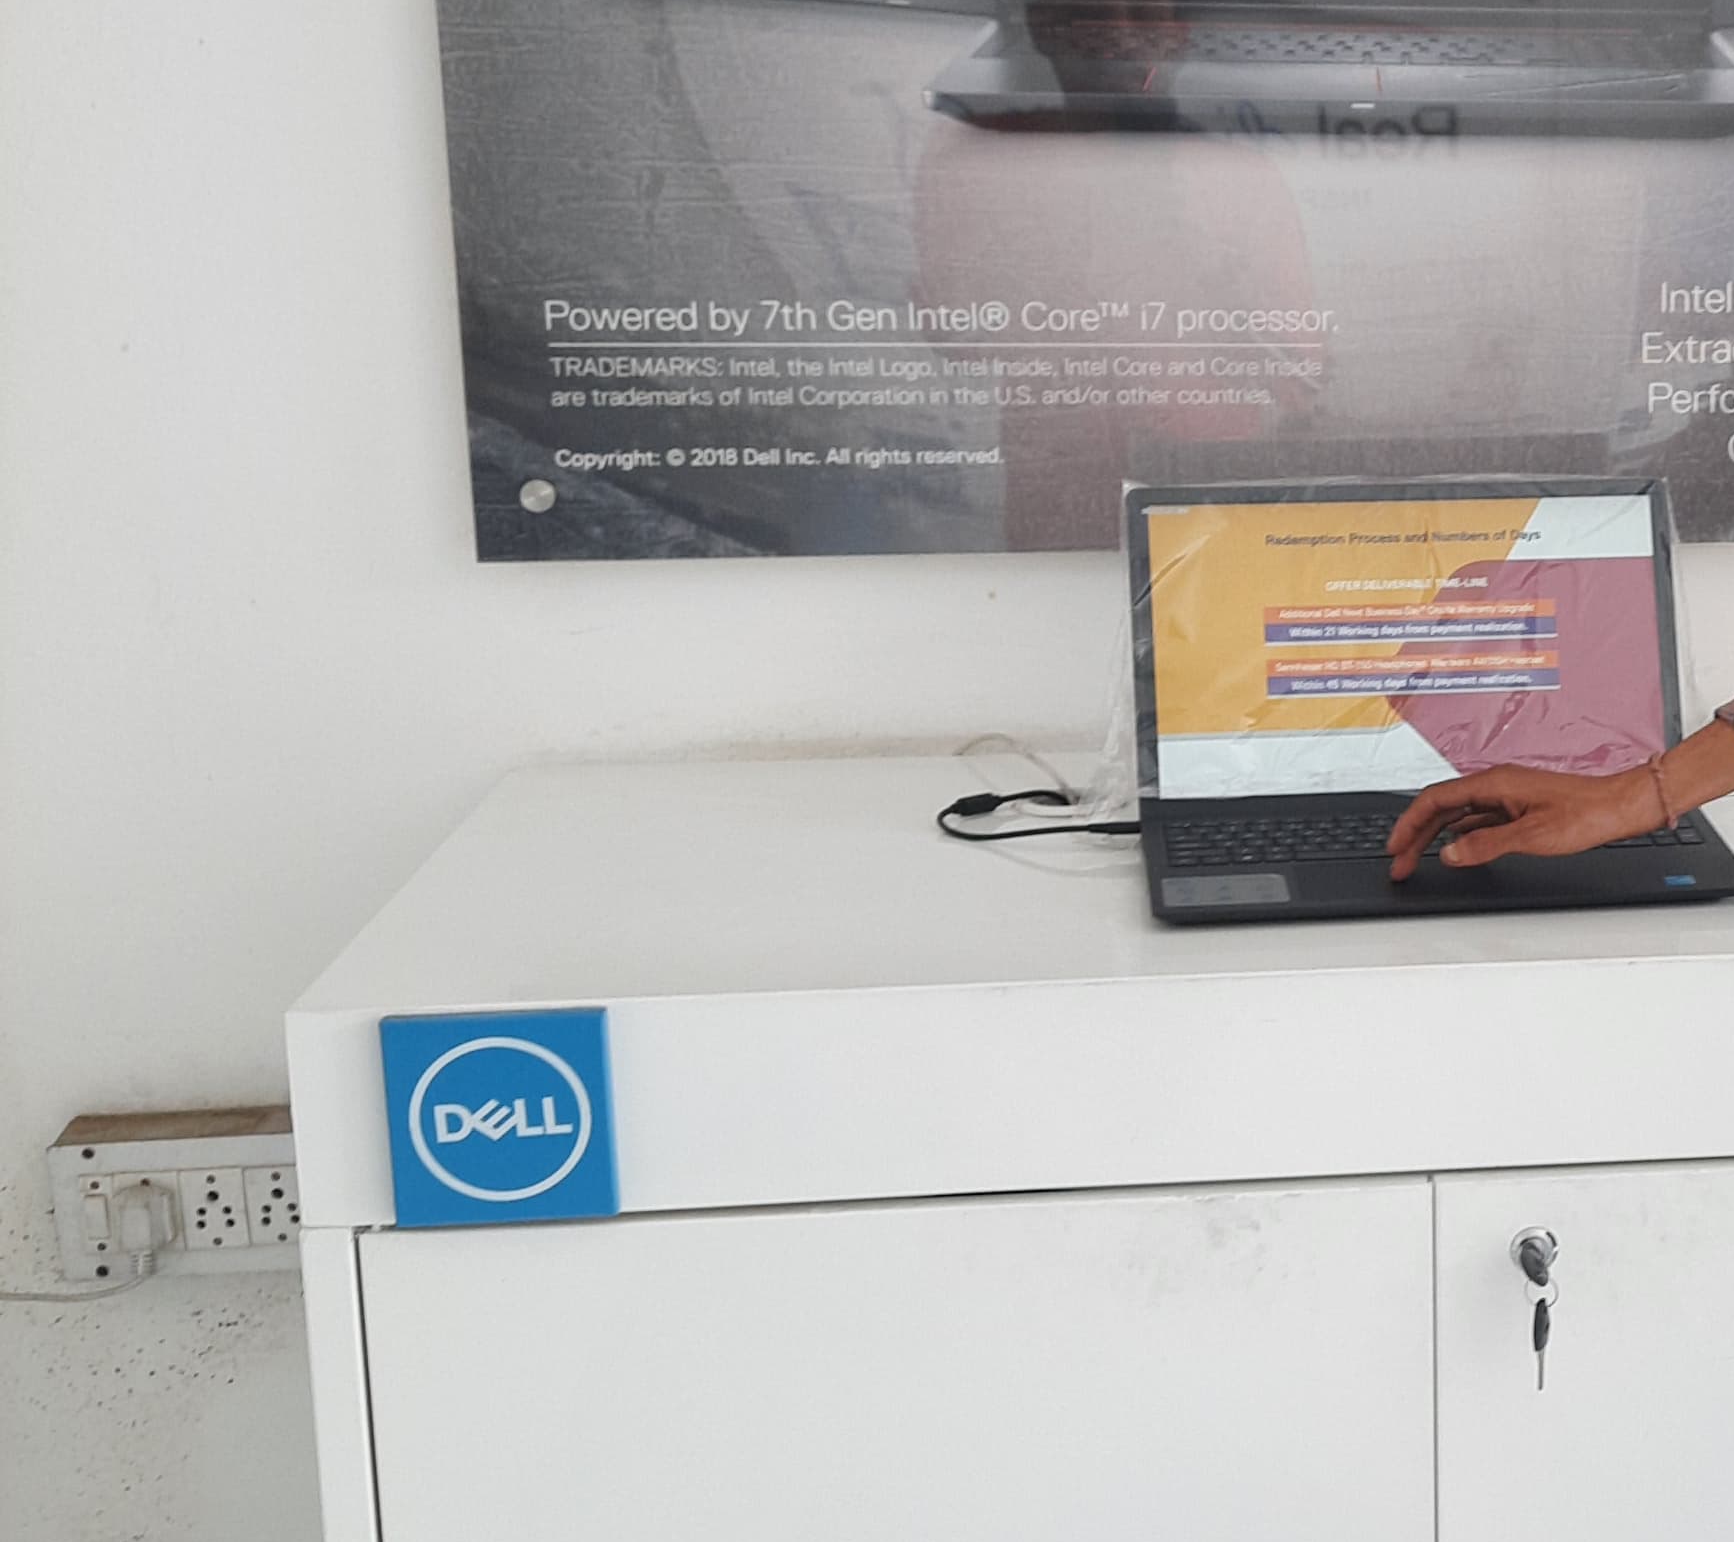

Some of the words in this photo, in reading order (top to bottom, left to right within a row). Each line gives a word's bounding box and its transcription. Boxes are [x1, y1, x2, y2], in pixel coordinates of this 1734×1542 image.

[1660, 282, 1733, 315] Intel
[544, 299, 699, 332] Powered
[709, 300, 750, 337] by
[759, 299, 818, 332] 7th
[827, 299, 898, 332] Gen
[1139, 301, 1166, 332] i7
[1176, 308, 1340, 340] processor.
[550, 357, 725, 378] TRADEMARKS:
[787, 358, 823, 377] the
[829, 357, 873, 377] Intel
[943, 357, 988, 377] Intel
[1063, 357, 1107, 377] Intel
[1112, 356, 1161, 377] Core
[1167, 357, 1205, 377] and
[1210, 356, 1259, 377] Core
[1264, 357, 1322, 377] Inside
[551, 390, 586, 407] are
[592, 386, 713, 407] trademarks
[719, 386, 743, 406] of
[748, 386, 793, 406] Intel
[799, 385, 924, 409] Corporation
[930, 387, 949, 405] in
[953, 386, 989, 405] the
[994, 385, 1036, 405] U.S.
[1042, 385, 1111, 405] and/or
[1116, 386, 1172, 405] other
[554, 447, 661, 471] Copyright:
[690, 446, 738, 467] 2018
[743, 447, 779, 466] Dell
[785, 447, 822, 466] Inc.
[825, 446, 850, 465] All
[855, 446, 911, 470] rights
[916, 445, 1006, 466] reserved.
[1265, 533, 1345, 548] Redemption
[1350, 532, 1400, 545] Process
[1404, 531, 1428, 544] and
[1431, 530, 1489, 544] Numbers
[1493, 530, 1507, 542] of
[432, 1096, 574, 1143] DELL
